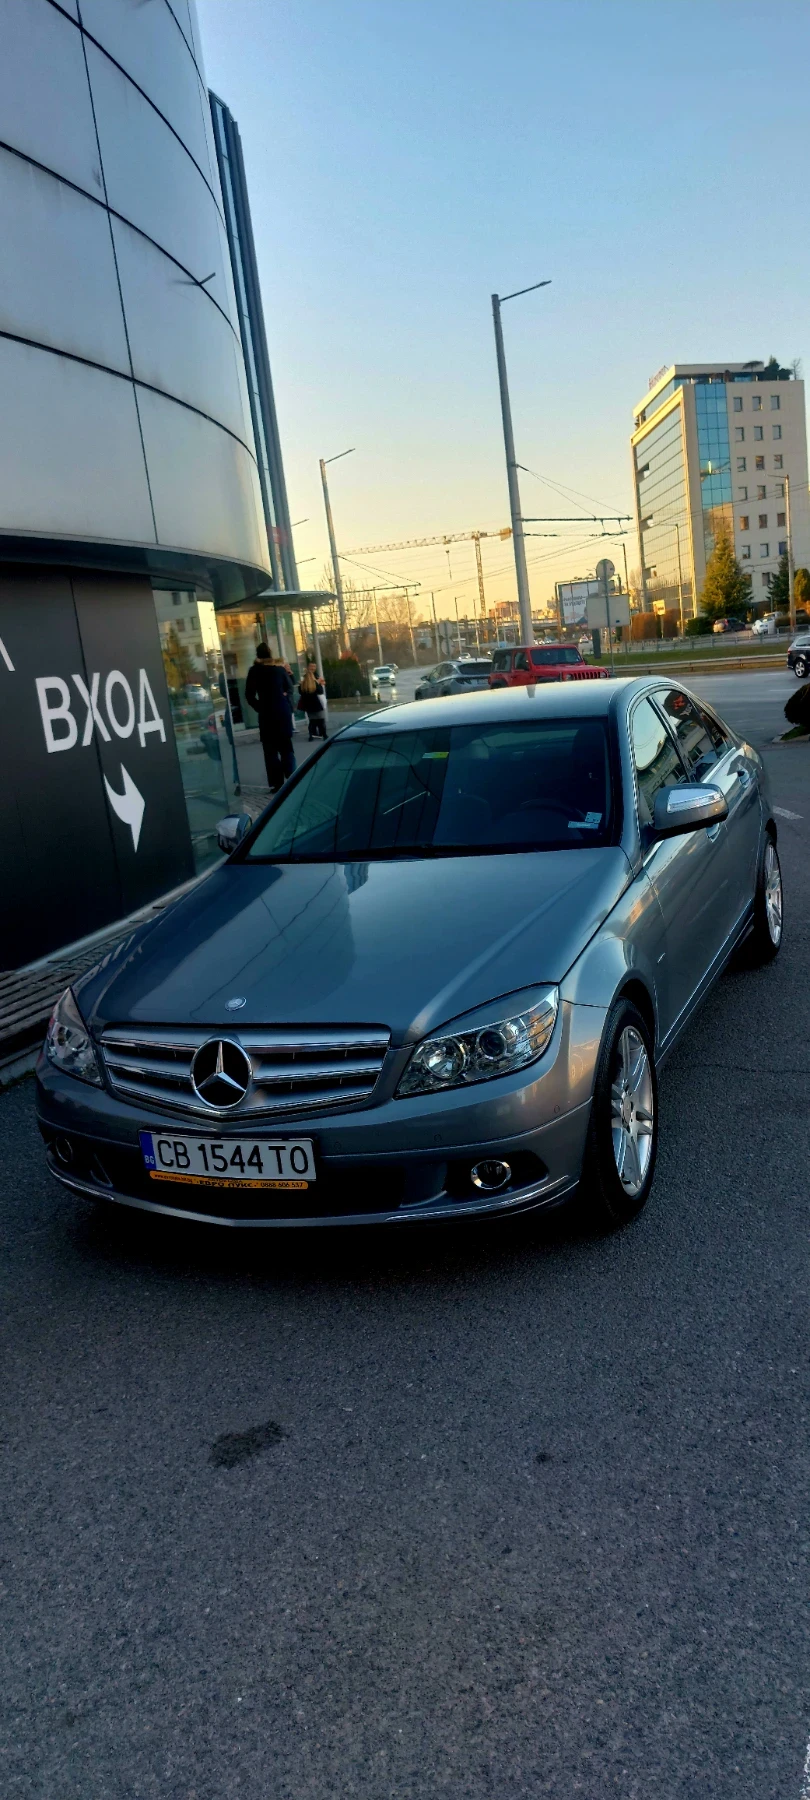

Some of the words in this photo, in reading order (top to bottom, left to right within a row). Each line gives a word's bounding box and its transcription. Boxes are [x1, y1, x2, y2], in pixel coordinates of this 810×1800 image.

[35, 668, 166, 753] ВХОД
[144, 1154, 154, 1164] BG
[157, 1139, 191, 1169] CB
[197, 1143, 264, 1174] 1544
